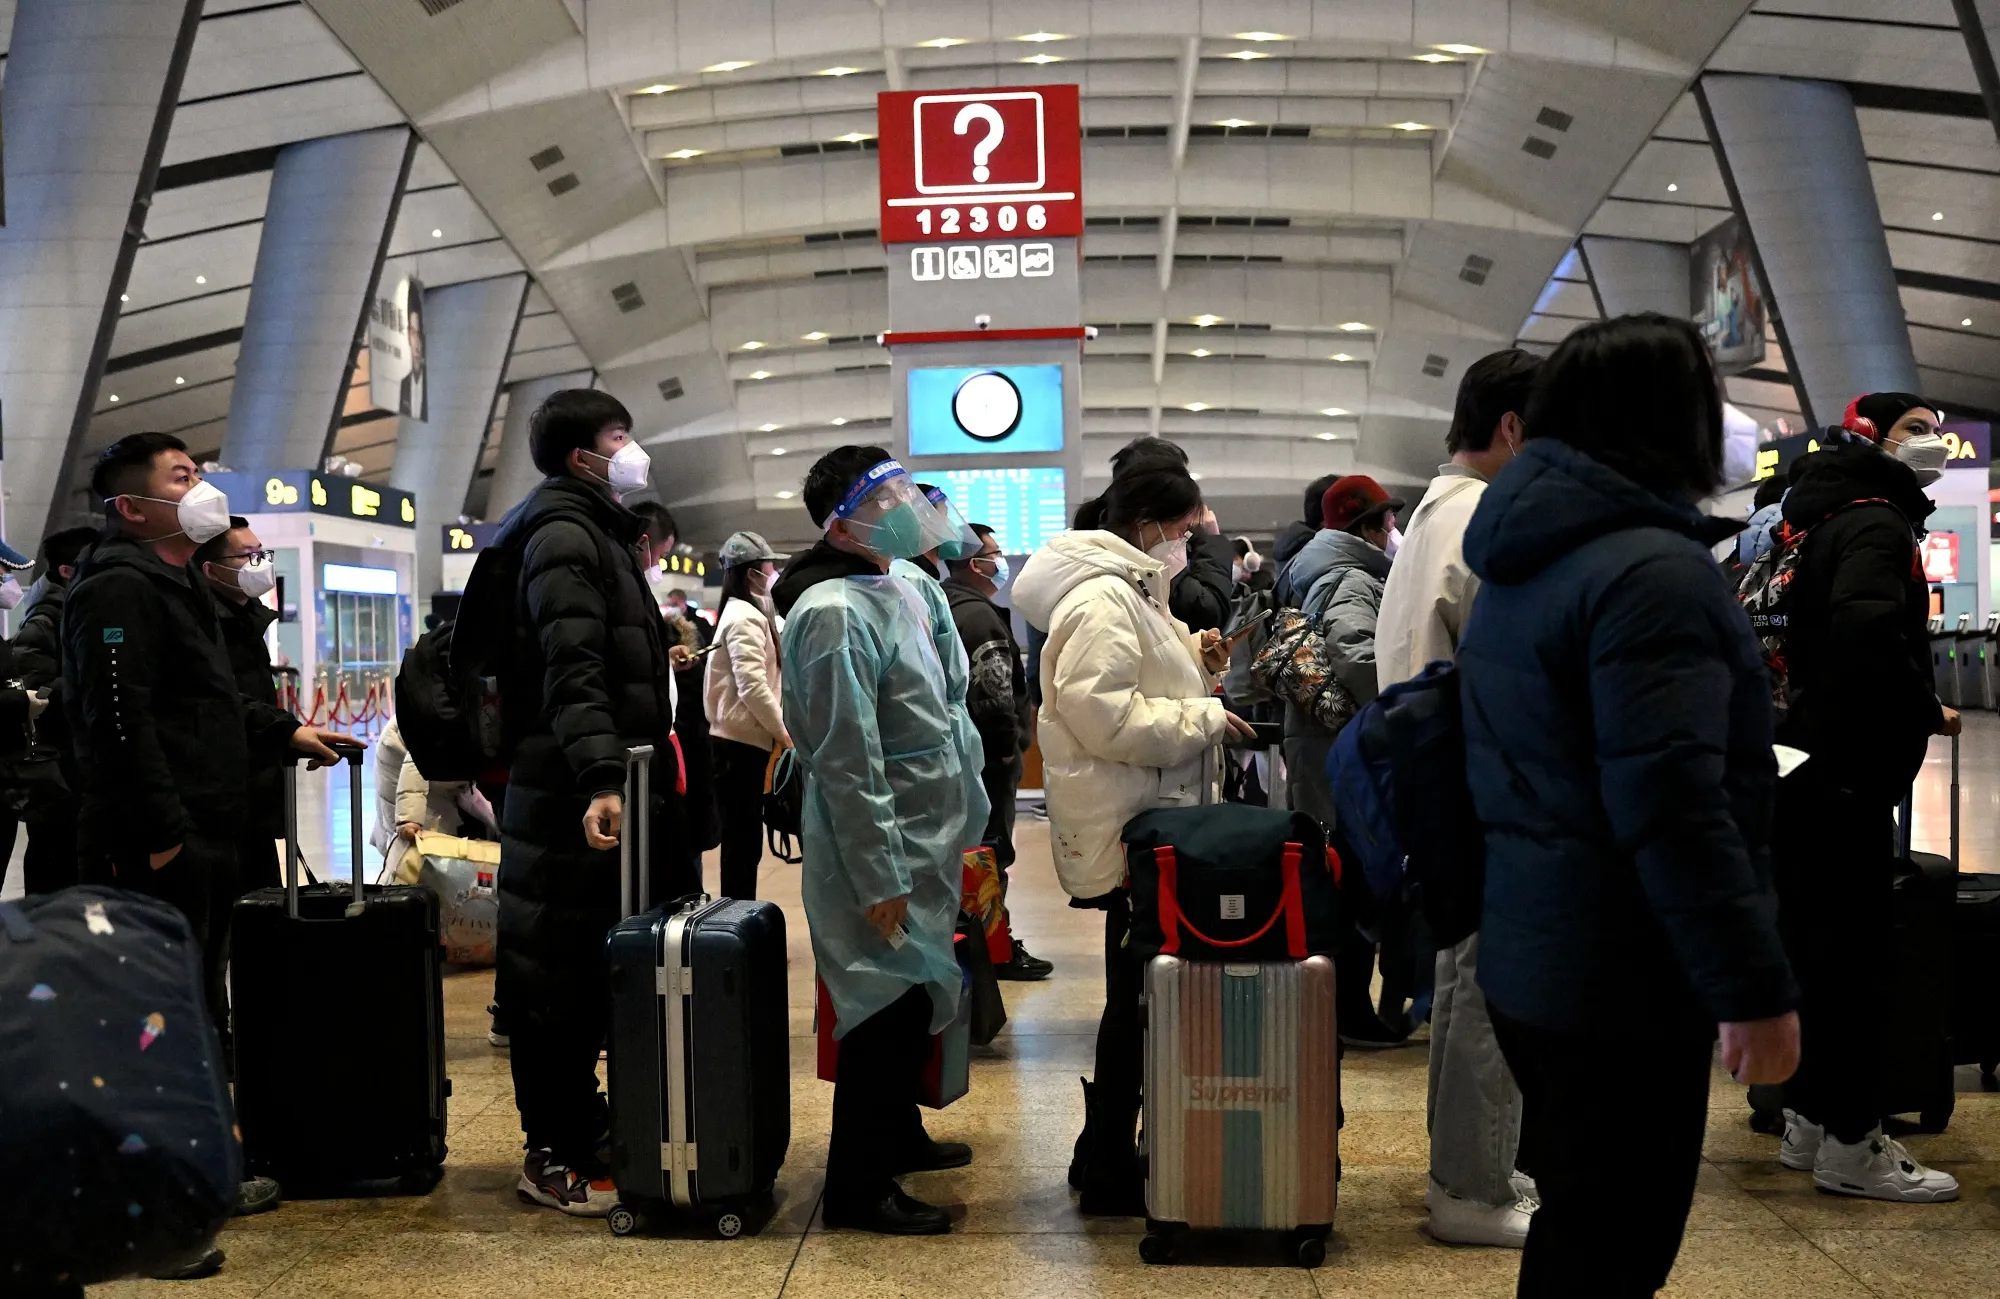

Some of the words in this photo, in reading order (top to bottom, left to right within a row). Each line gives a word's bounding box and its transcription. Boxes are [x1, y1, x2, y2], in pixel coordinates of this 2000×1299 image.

[916, 204, 1047, 235] 12306
[1942, 432, 1977, 460] 9A
[1189, 1078, 1289, 1106] Supreme
